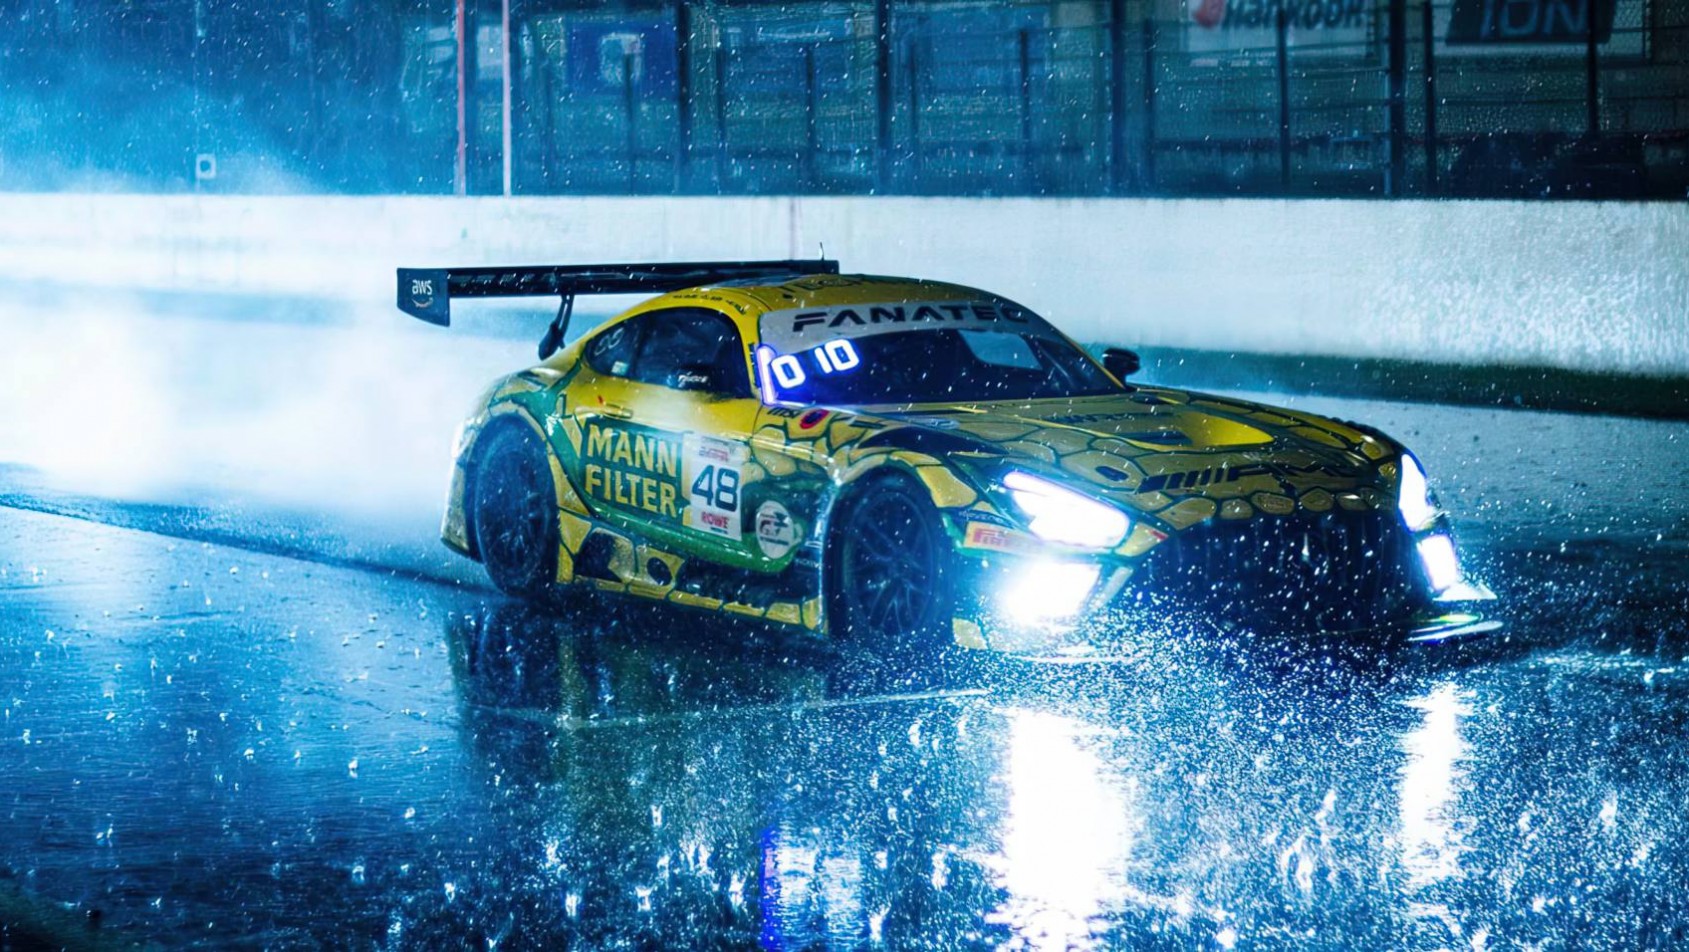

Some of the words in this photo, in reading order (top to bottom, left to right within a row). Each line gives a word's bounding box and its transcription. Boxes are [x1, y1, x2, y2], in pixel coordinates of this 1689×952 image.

[412, 279, 433, 295] aws
[792, 305, 1028, 333] FANATEC
[815, 338, 859, 373] 10
[587, 424, 678, 478] MANN
[584, 464, 677, 518] FILTER
[691, 464, 740, 512] 48
[701, 511, 729, 529] ROWE
